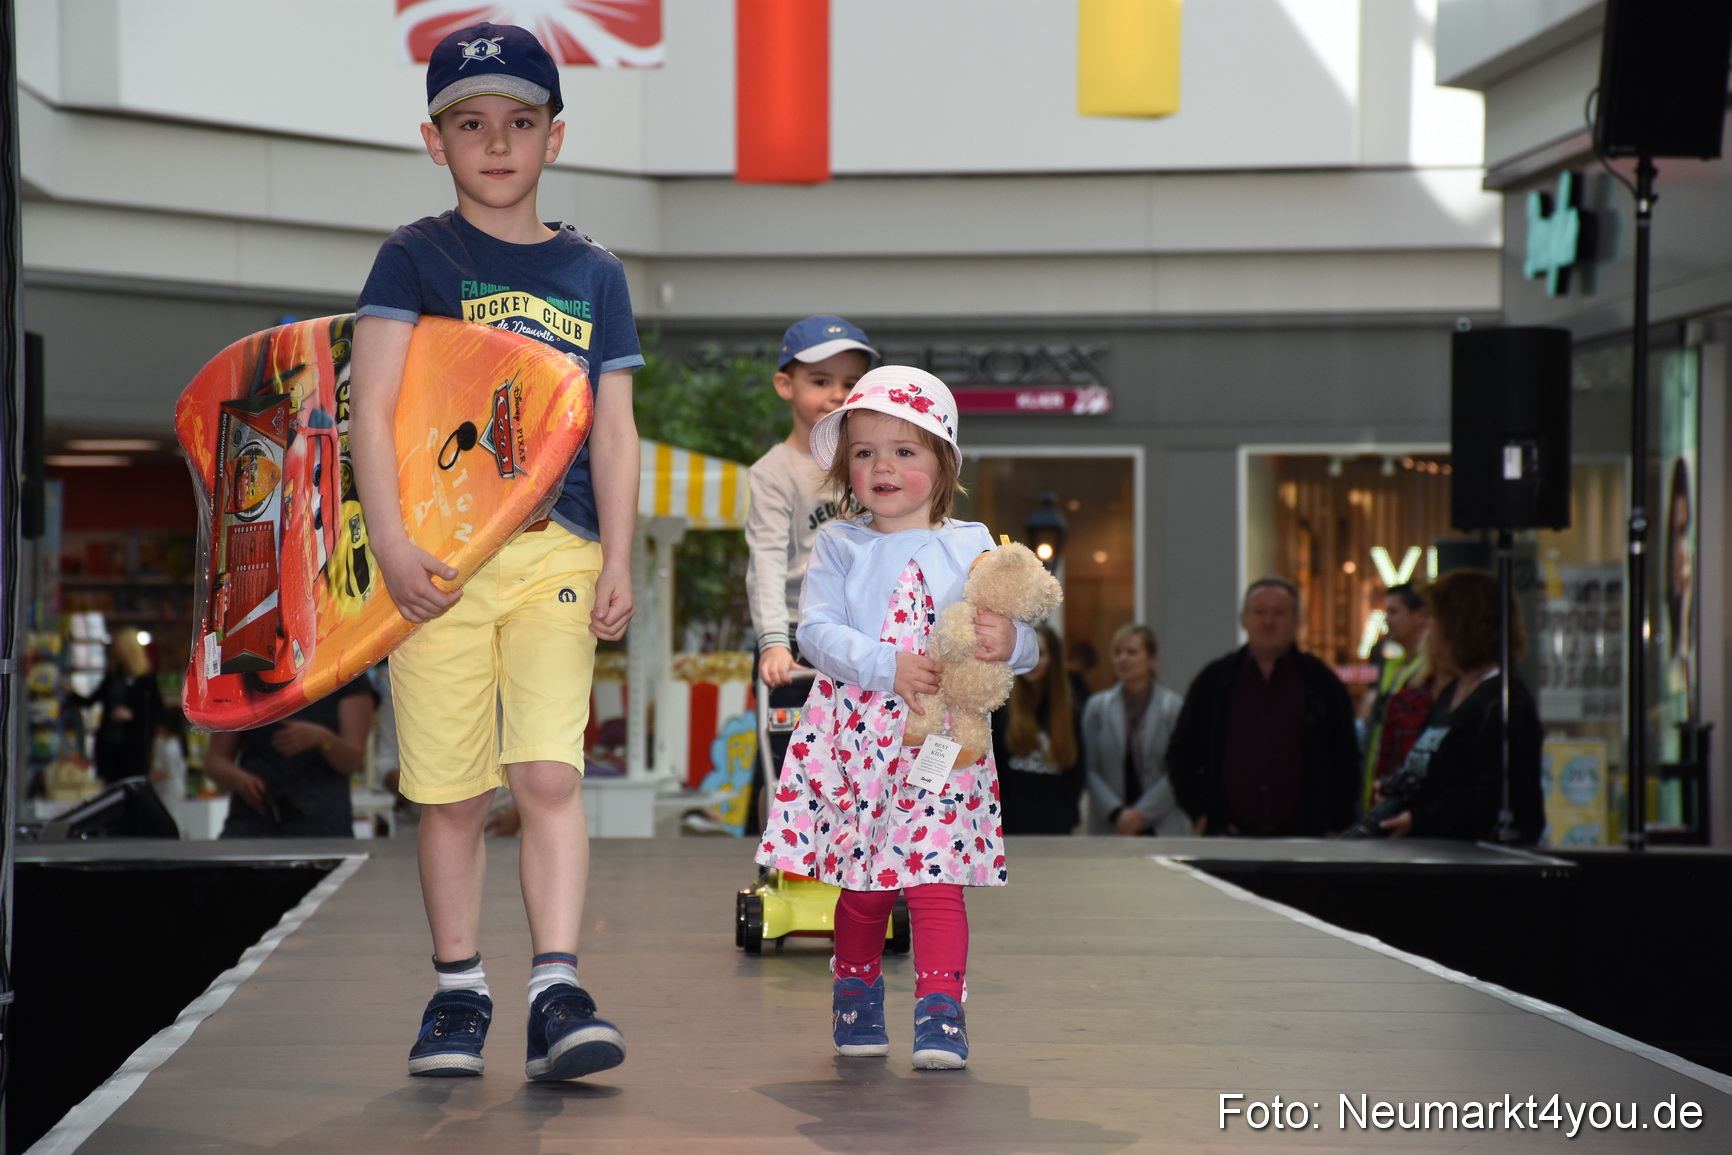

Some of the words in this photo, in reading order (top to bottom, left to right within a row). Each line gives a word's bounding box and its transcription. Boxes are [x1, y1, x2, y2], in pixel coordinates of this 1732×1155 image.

[469, 296, 530, 323] JOCKEY
[543, 308, 583, 340] CLUB
[514, 382, 523, 421] Disney
[219, 413, 228, 478] SCHWIMMBRETT
[497, 396, 509, 466] Cars
[516, 428, 526, 464] PIXAR
[931, 750, 945, 758] KIDS
[934, 742, 949, 750] BEST
